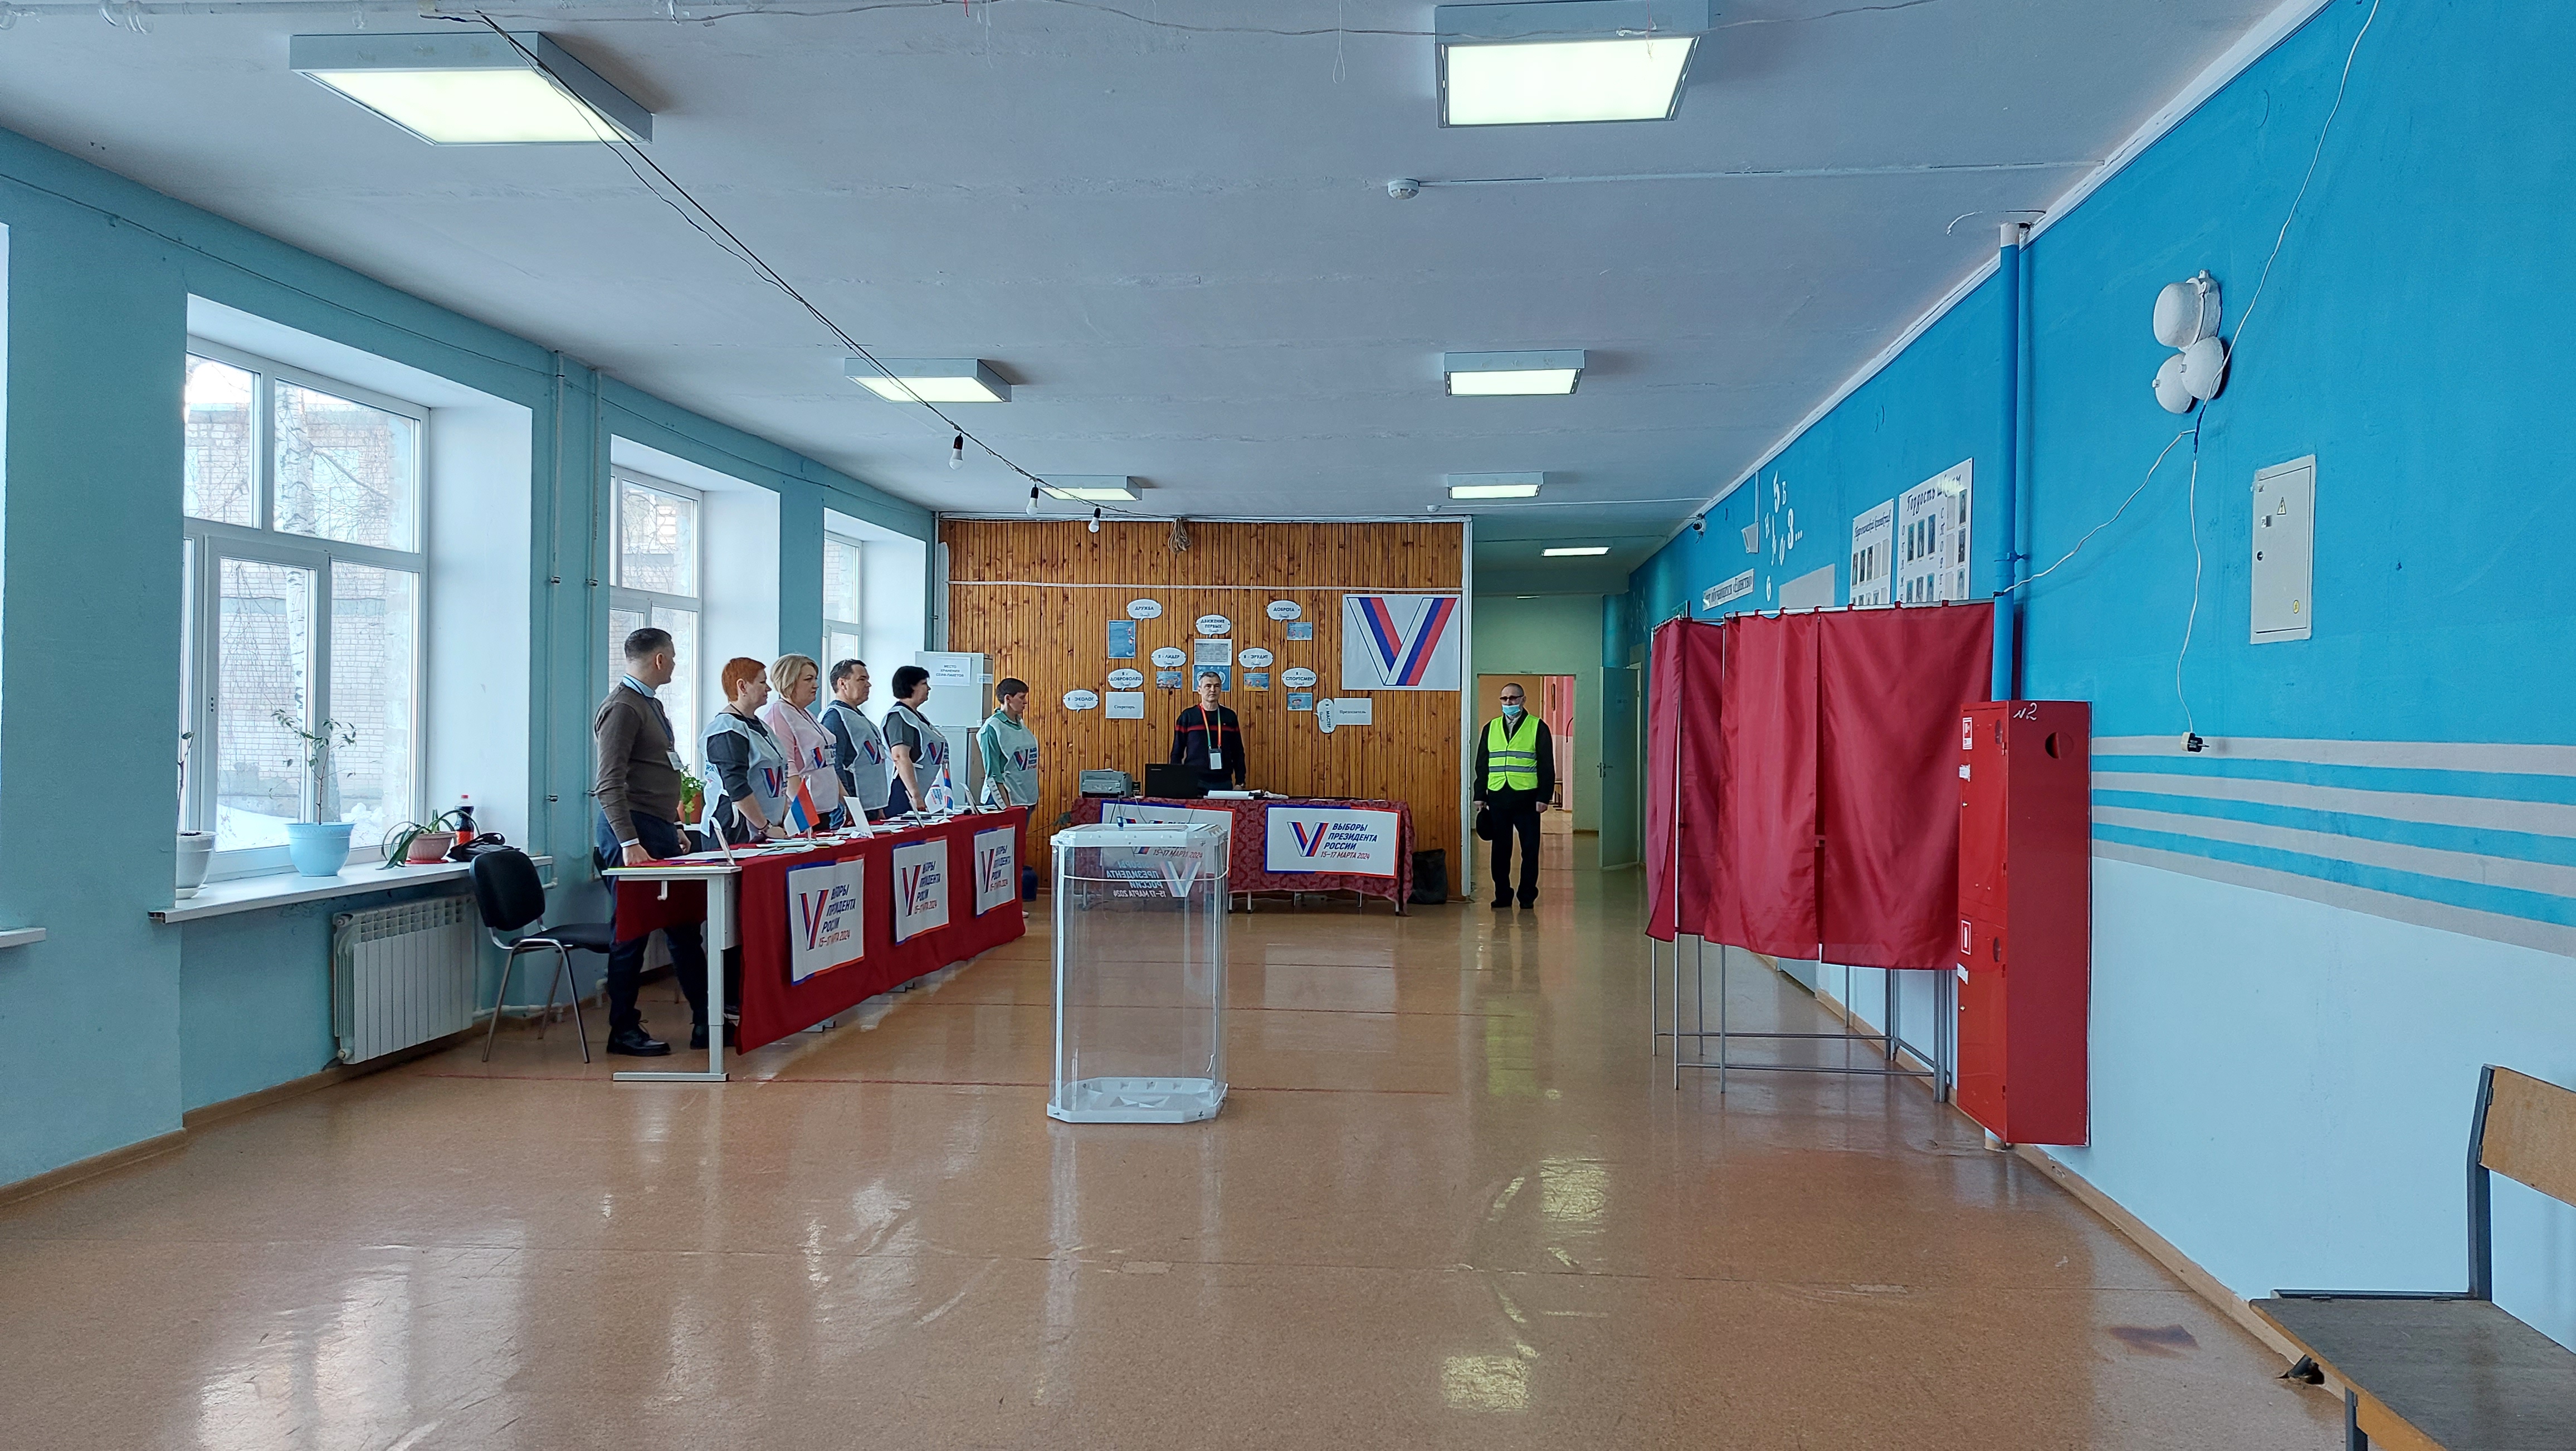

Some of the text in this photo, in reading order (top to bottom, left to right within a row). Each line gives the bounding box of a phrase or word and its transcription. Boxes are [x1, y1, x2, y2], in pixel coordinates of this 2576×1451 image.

[1907, 474, 1962, 516] Гордость шкы
[1332, 823, 1368, 831] ВЫБОРЫ
[1328, 832, 1378, 842] ПРЕЗИДЕНТА
[1324, 842, 1357, 850] РОССИИ
